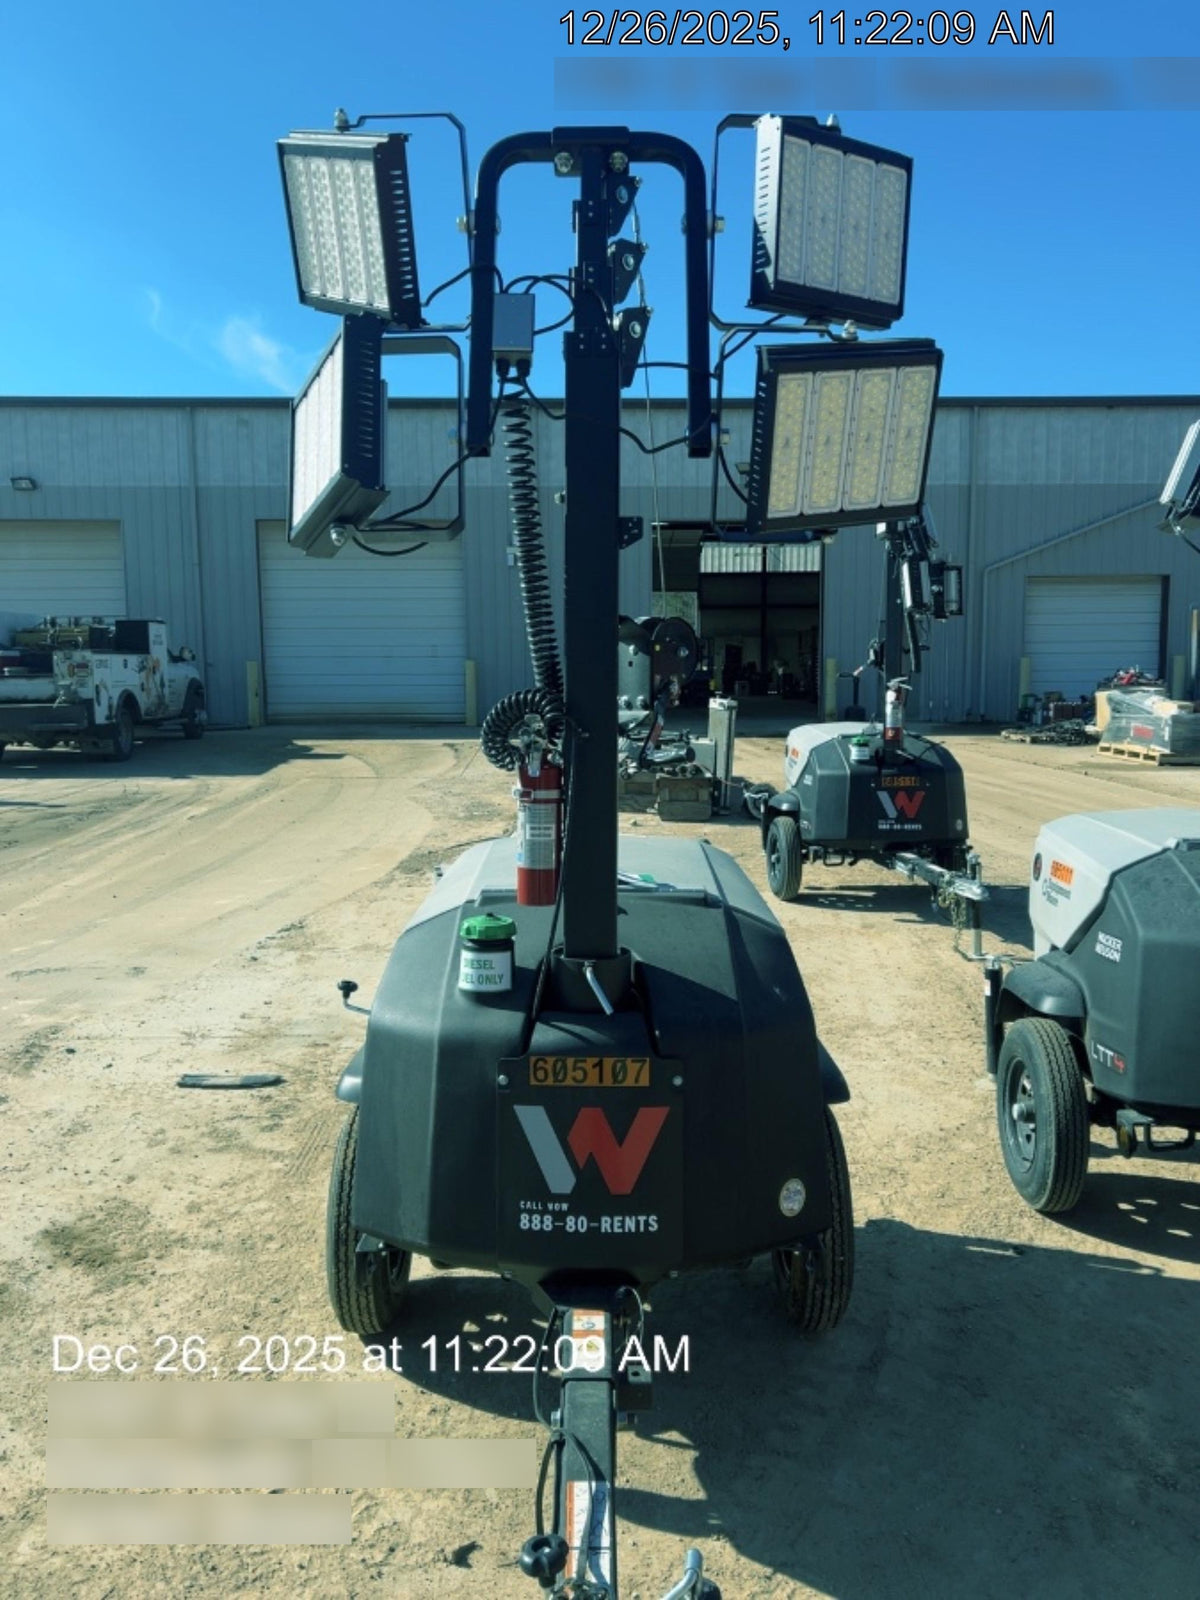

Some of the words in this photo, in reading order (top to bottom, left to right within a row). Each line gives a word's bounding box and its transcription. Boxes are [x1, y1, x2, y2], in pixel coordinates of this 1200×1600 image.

[477, 973, 504, 985] ONLY
[1090, 1039, 1126, 1074] LTT4
[532, 1057, 648, 1085] 605107
[519, 1213, 659, 1233] 888-80-RENTS
